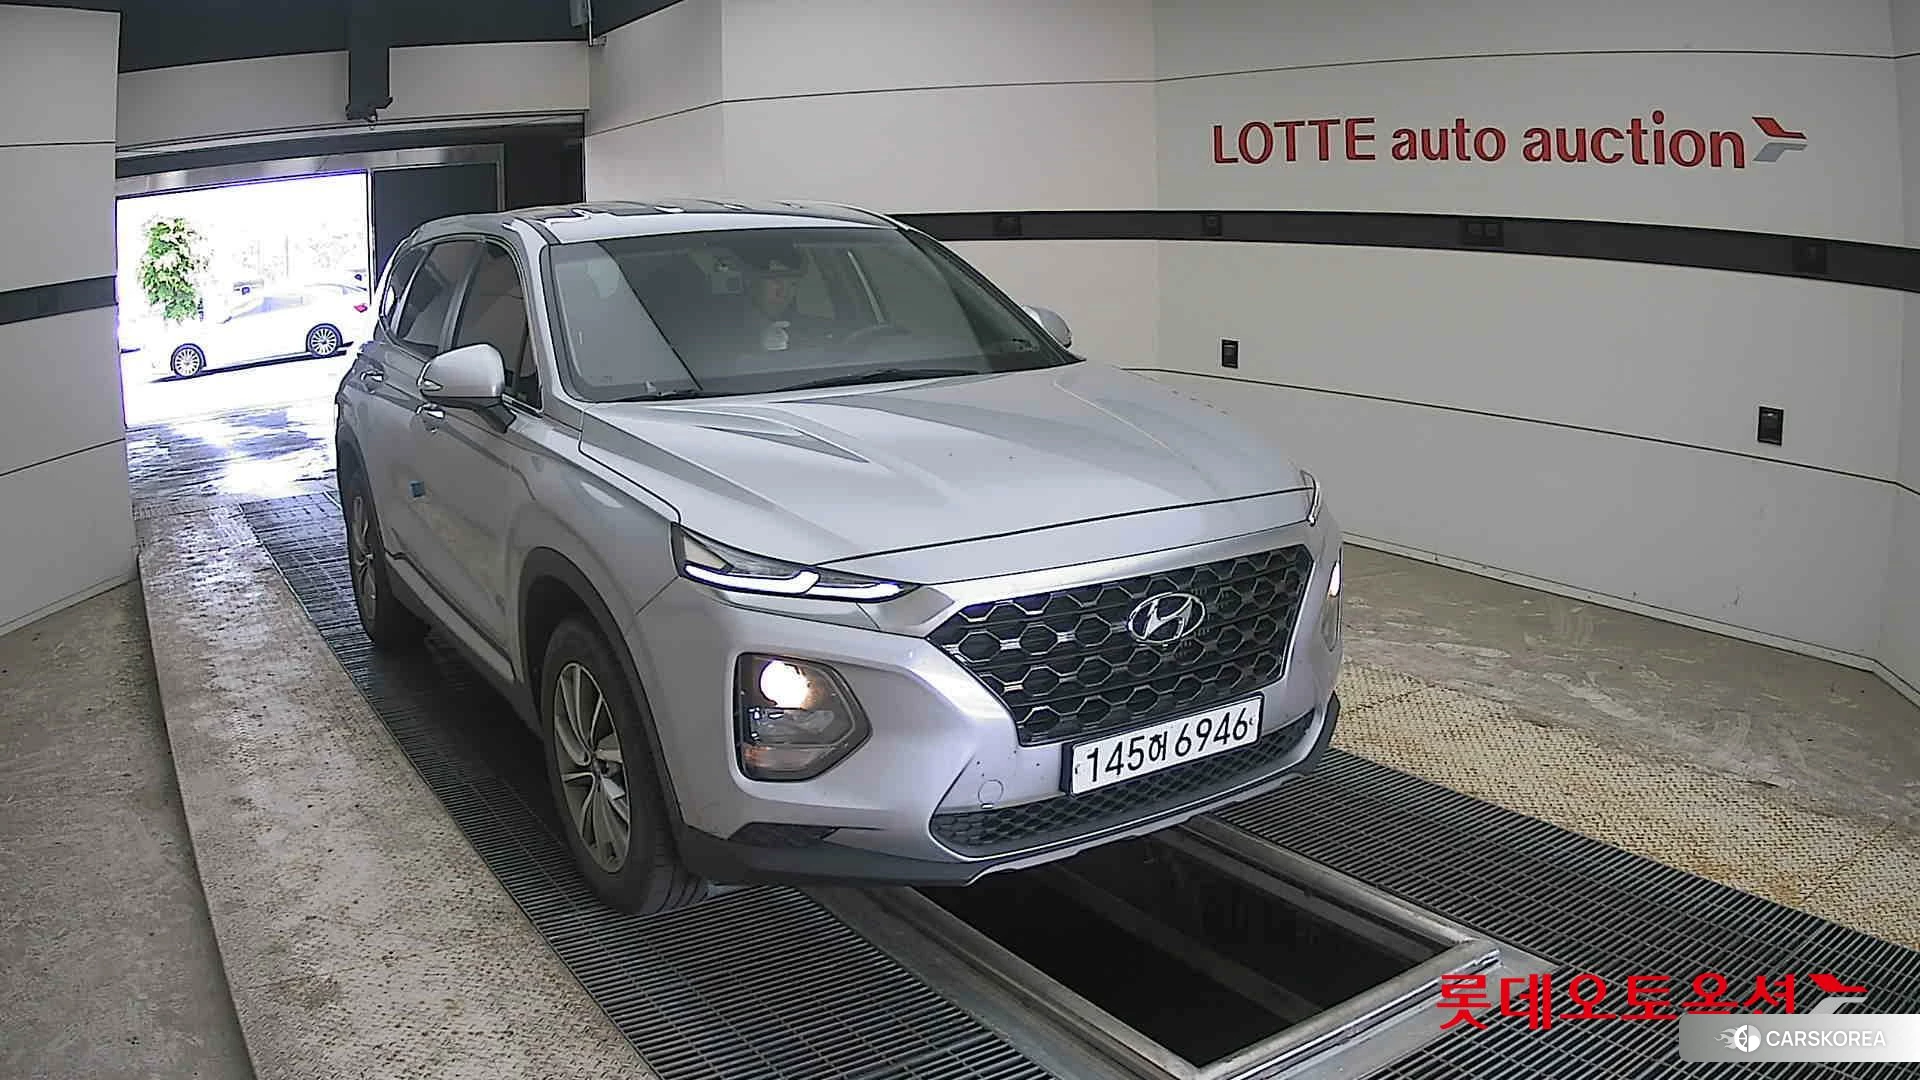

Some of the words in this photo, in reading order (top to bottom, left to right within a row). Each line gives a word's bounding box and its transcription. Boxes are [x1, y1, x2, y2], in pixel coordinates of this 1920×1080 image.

[1212, 117, 1376, 164] LOTTE
[1391, 117, 1506, 162] auto
[1521, 110, 1746, 168] auction
[1174, 707, 1249, 757] 6946
